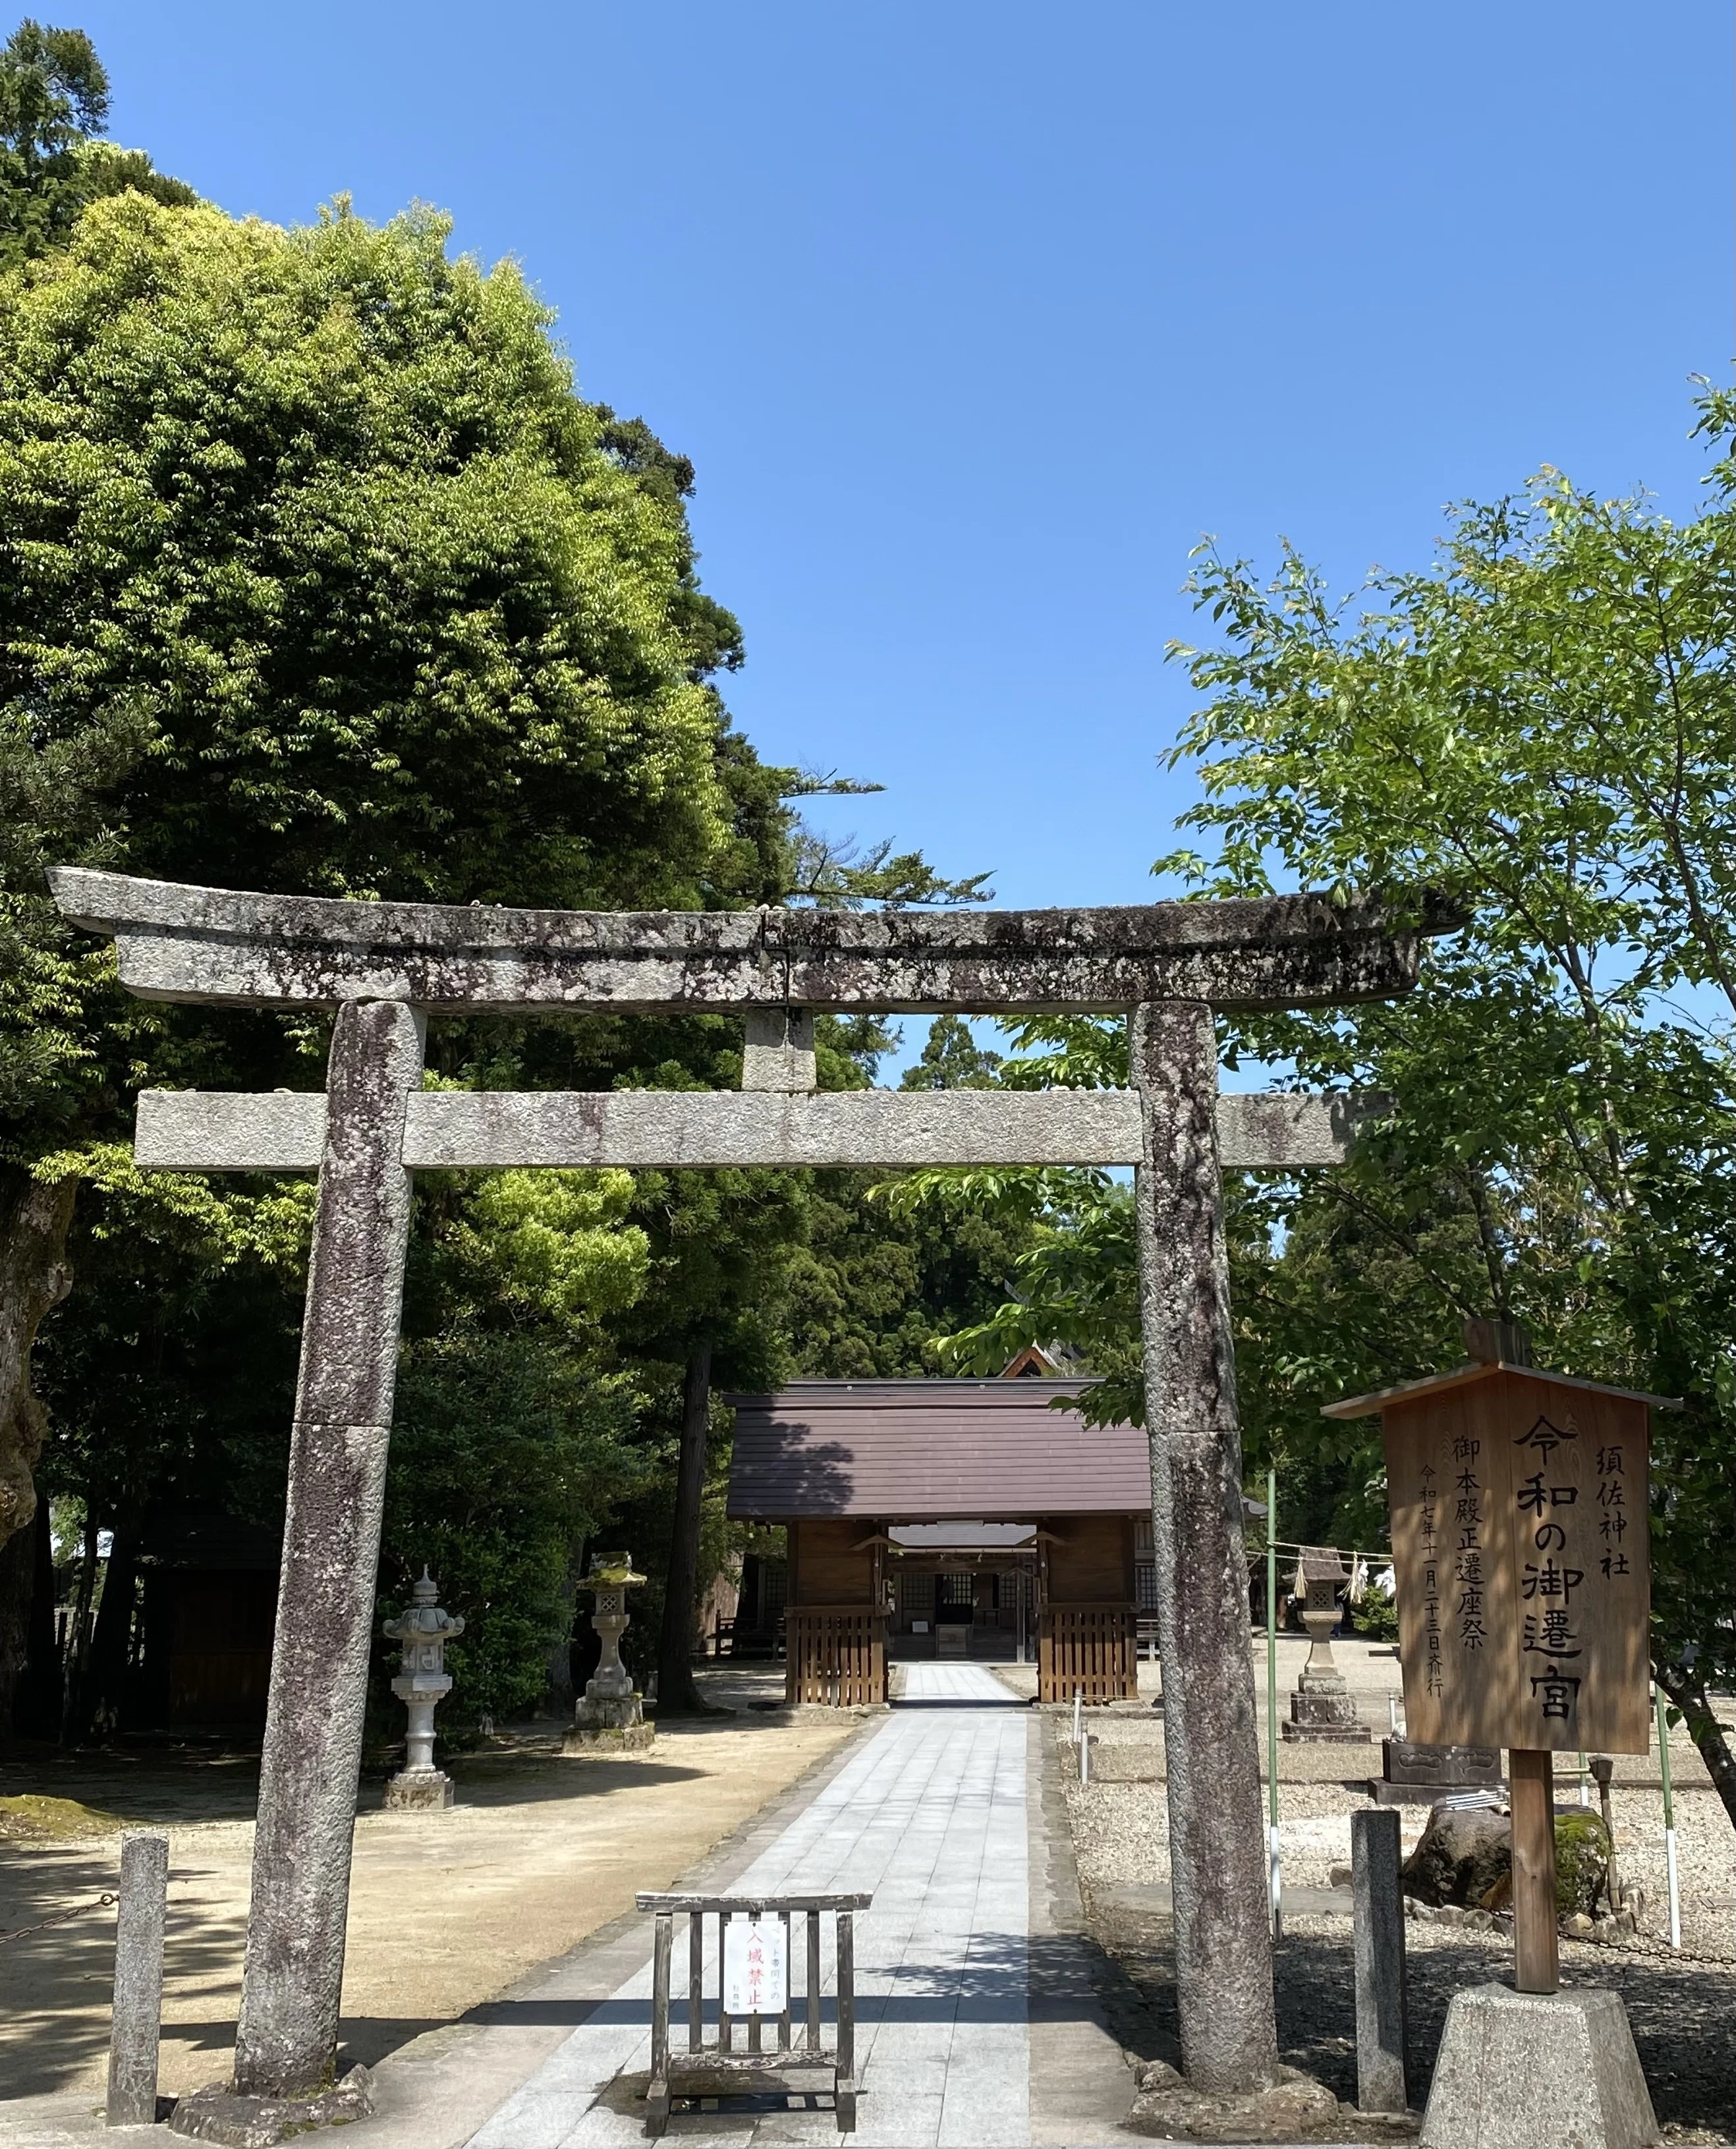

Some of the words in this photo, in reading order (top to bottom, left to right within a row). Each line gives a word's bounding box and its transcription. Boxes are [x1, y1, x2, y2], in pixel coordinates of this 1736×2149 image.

[1451, 1435, 1488, 1650] 御本殿正遷座祭
[1513, 1414, 1584, 1719] 令和の御遷宮
[1595, 1445, 1630, 1580] 須佐神社
[746, 1928, 764, 2006] 入域禁止
